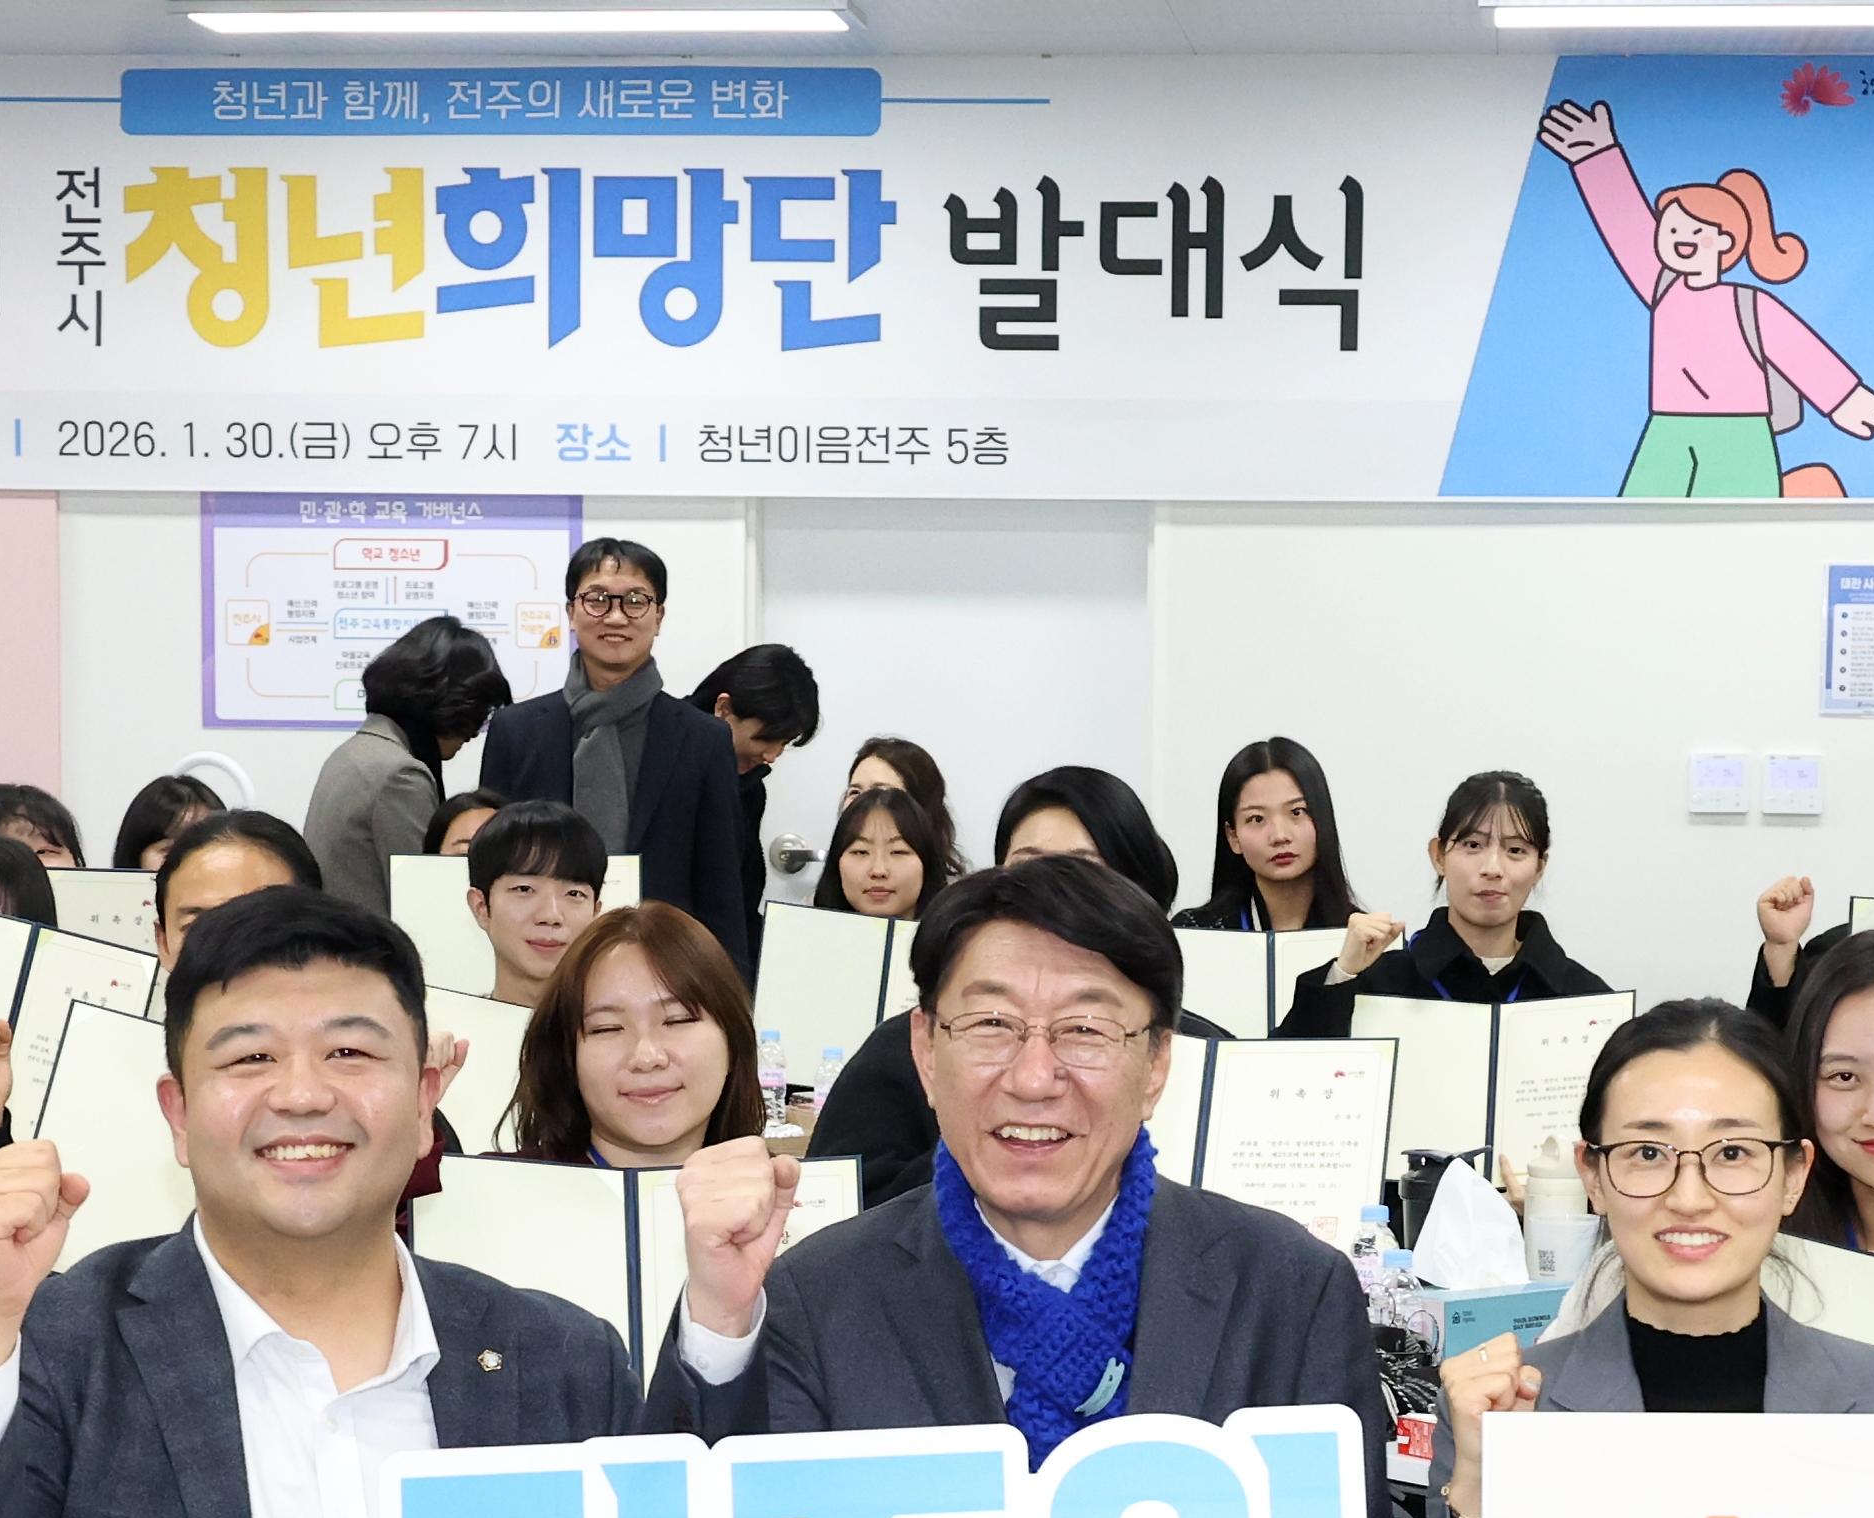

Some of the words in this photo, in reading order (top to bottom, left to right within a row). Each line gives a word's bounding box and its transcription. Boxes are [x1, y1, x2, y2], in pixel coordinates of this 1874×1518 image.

[211, 79, 328, 122] 청년과
[343, 79, 431, 124] 함께,
[446, 80, 563, 121] 전주의
[577, 80, 696, 121] 새로운
[710, 79, 789, 121] 변화
[55, 166, 106, 347] 전주시
[123, 165, 897, 352] 청년희망단
[944, 175, 1365, 352] 발대식
[57, 420, 167, 459] 2026.
[183, 420, 211, 459] 1.
[225, 420, 351, 463] 30.(금)
[368, 421, 443, 461] 오후
[457, 422, 519, 462] 7시
[555, 422, 632, 462] 장소
[698, 423, 931, 466] 청년이음전주
[946, 426, 1009, 466] 5층
[374, 501, 408, 524] 교육
[416, 501, 484, 525] 거버넌스
[362, 548, 383, 561] 학교
[388, 548, 421, 561] 청소년
